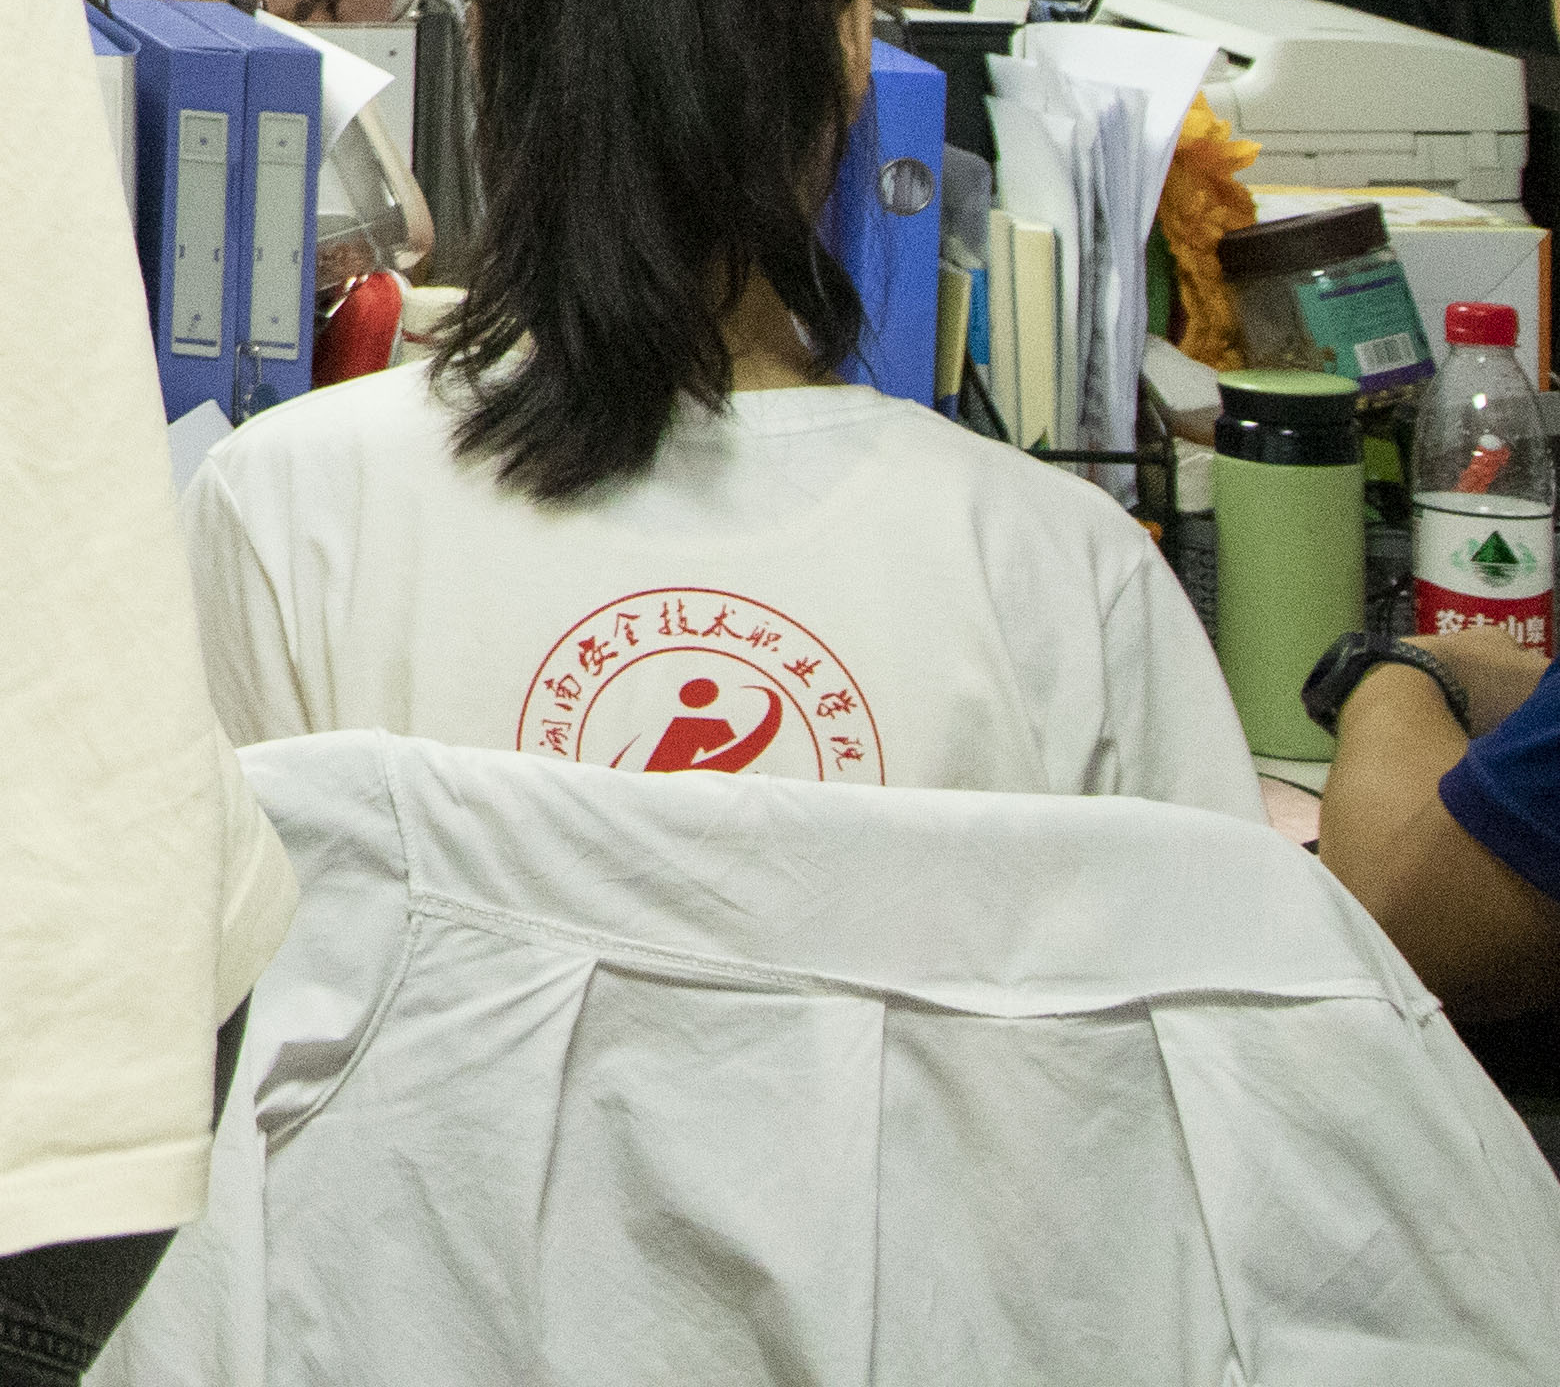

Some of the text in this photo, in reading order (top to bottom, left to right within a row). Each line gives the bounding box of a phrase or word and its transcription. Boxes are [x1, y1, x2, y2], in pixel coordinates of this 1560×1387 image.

[539, 598, 867, 773] 湖南安全技术职业学院
